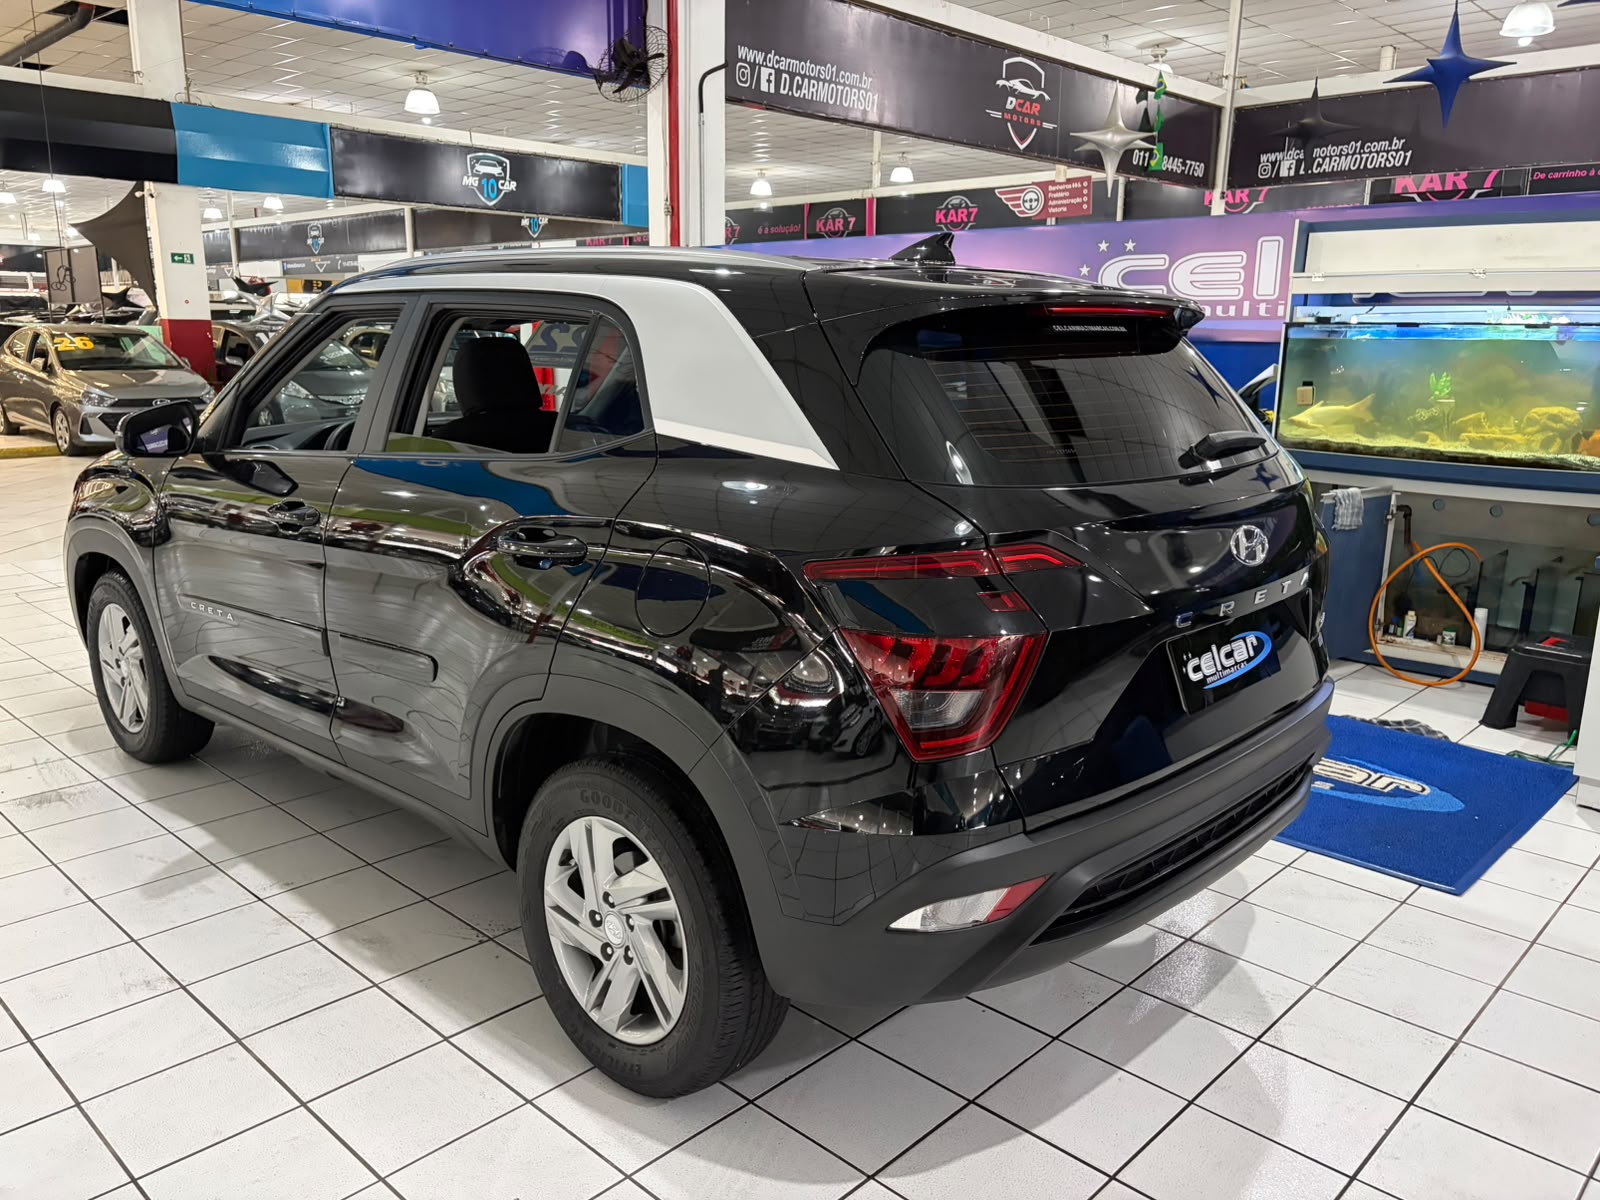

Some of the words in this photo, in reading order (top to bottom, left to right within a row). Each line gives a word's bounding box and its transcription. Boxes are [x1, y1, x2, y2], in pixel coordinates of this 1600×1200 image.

[737, 45, 873, 89] www.dcarmotors01.com.br
[779, 73, 880, 113] D.CARMOTORS01
[1005, 96, 1041, 117] DCAR
[1132, 149, 1149, 167] 011
[1548, 168, 1588, 179] carrinho
[462, 175, 479, 187] MG
[481, 178, 497, 199] 10
[498, 180, 517, 191] CAR
[816, 219, 845, 232] KAR
[54, 336, 95, 352] 26
[190, 601, 234, 621] CRETA
[1187, 634, 1258, 682] celcar
